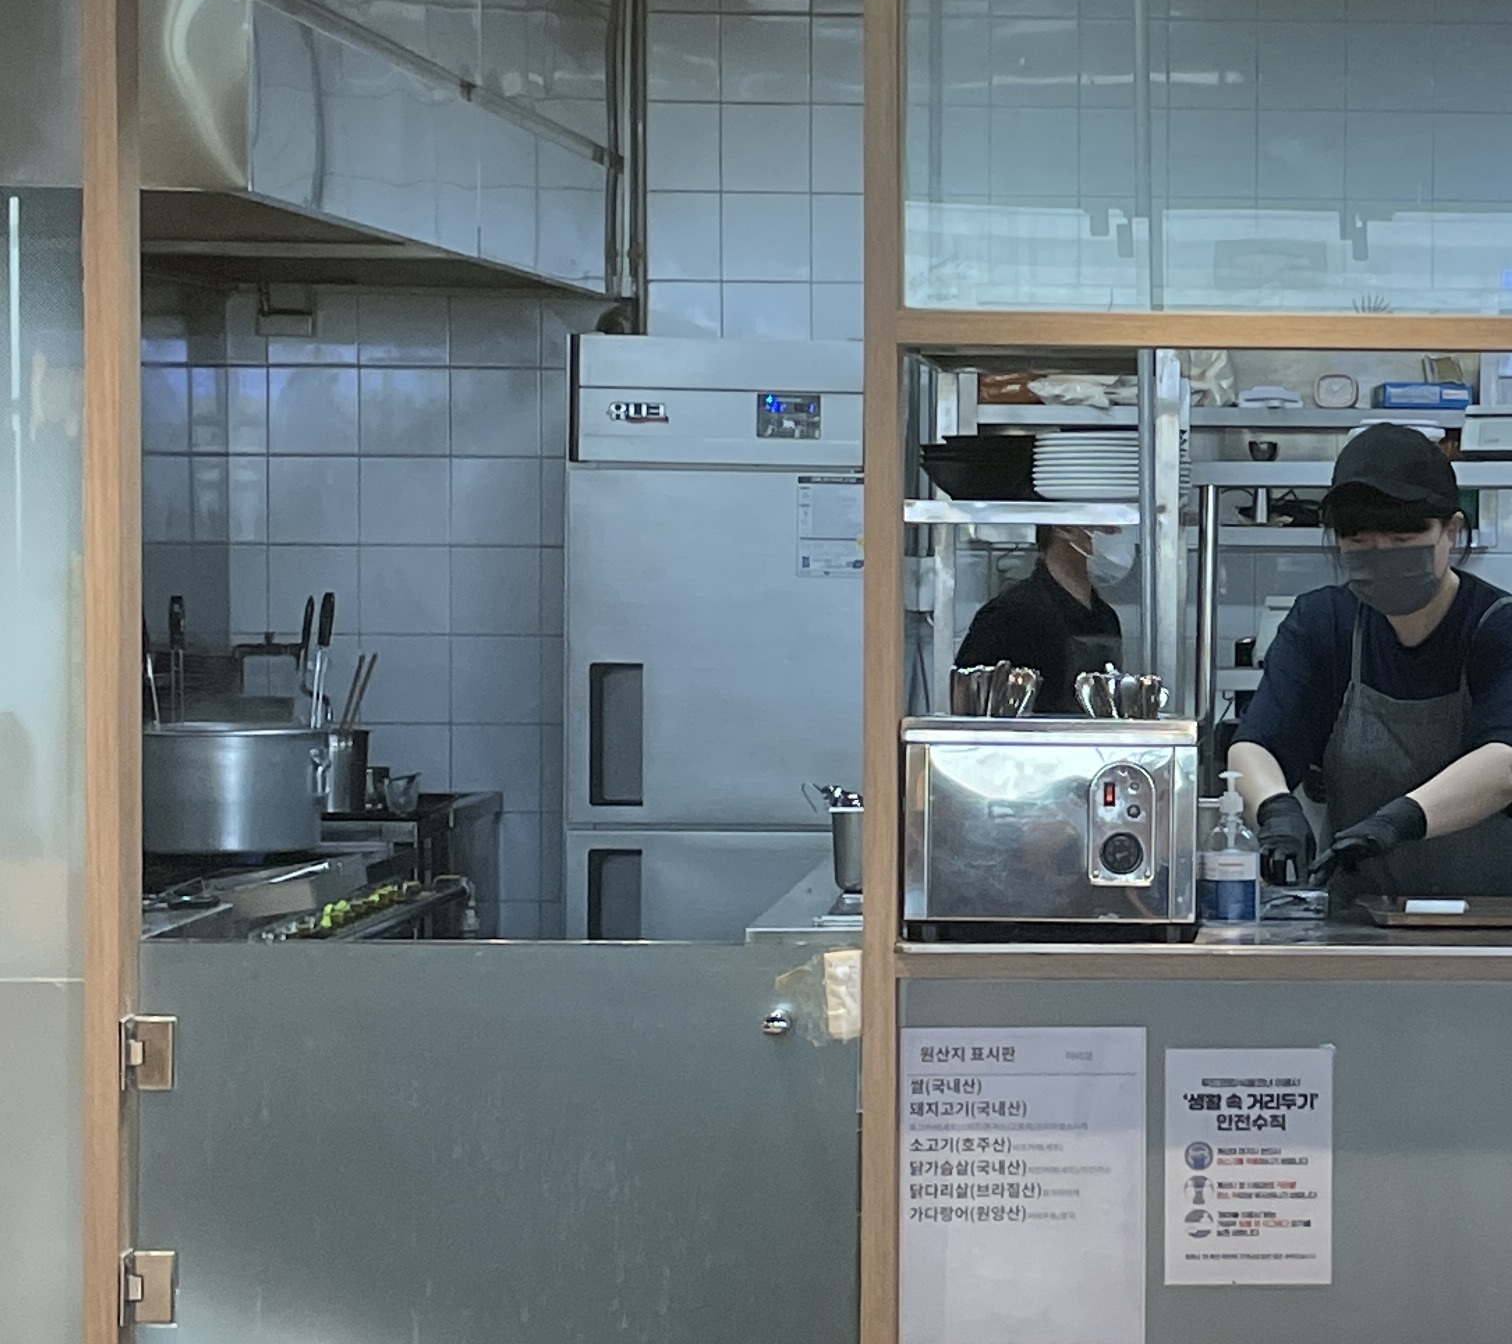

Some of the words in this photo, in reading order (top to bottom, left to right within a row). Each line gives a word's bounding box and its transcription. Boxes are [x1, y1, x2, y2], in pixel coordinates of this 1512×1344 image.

[920, 1046, 965, 1063] 원산지
[970, 1046, 1016, 1063] 표시판
[910, 1078, 982, 1095] 쌀(국내산)
[909, 1100, 1027, 1117] 돼지고기(국내산)
[909, 1137, 1013, 1154] 소고기(호주산)
[909, 1160, 1028, 1177] 닭가슴살(국내산)
[909, 1182, 1042, 1200] 닭다리살(브라질산)
